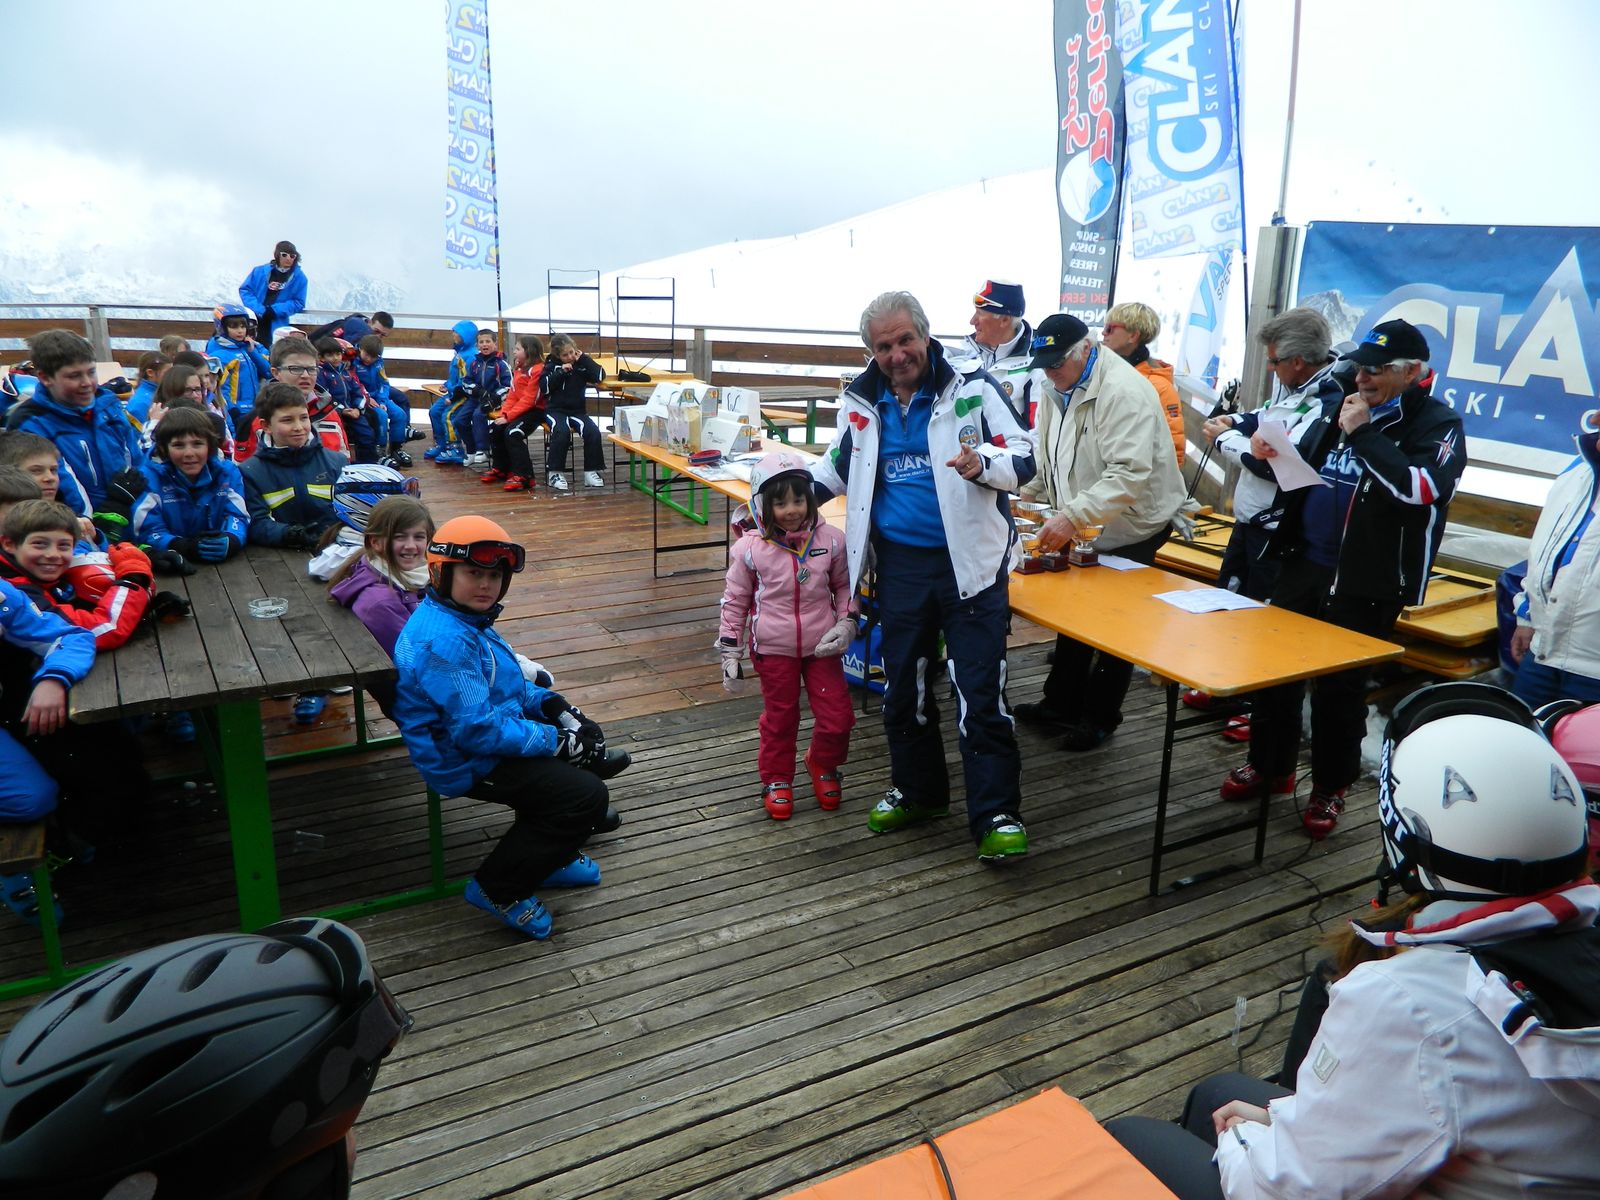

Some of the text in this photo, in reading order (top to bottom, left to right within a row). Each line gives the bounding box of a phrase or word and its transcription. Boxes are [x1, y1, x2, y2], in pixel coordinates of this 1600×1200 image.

[1205, 72, 1219, 112] SKI
[1443, 388, 1505, 419] SKI
[884, 453, 932, 479] CLAN
